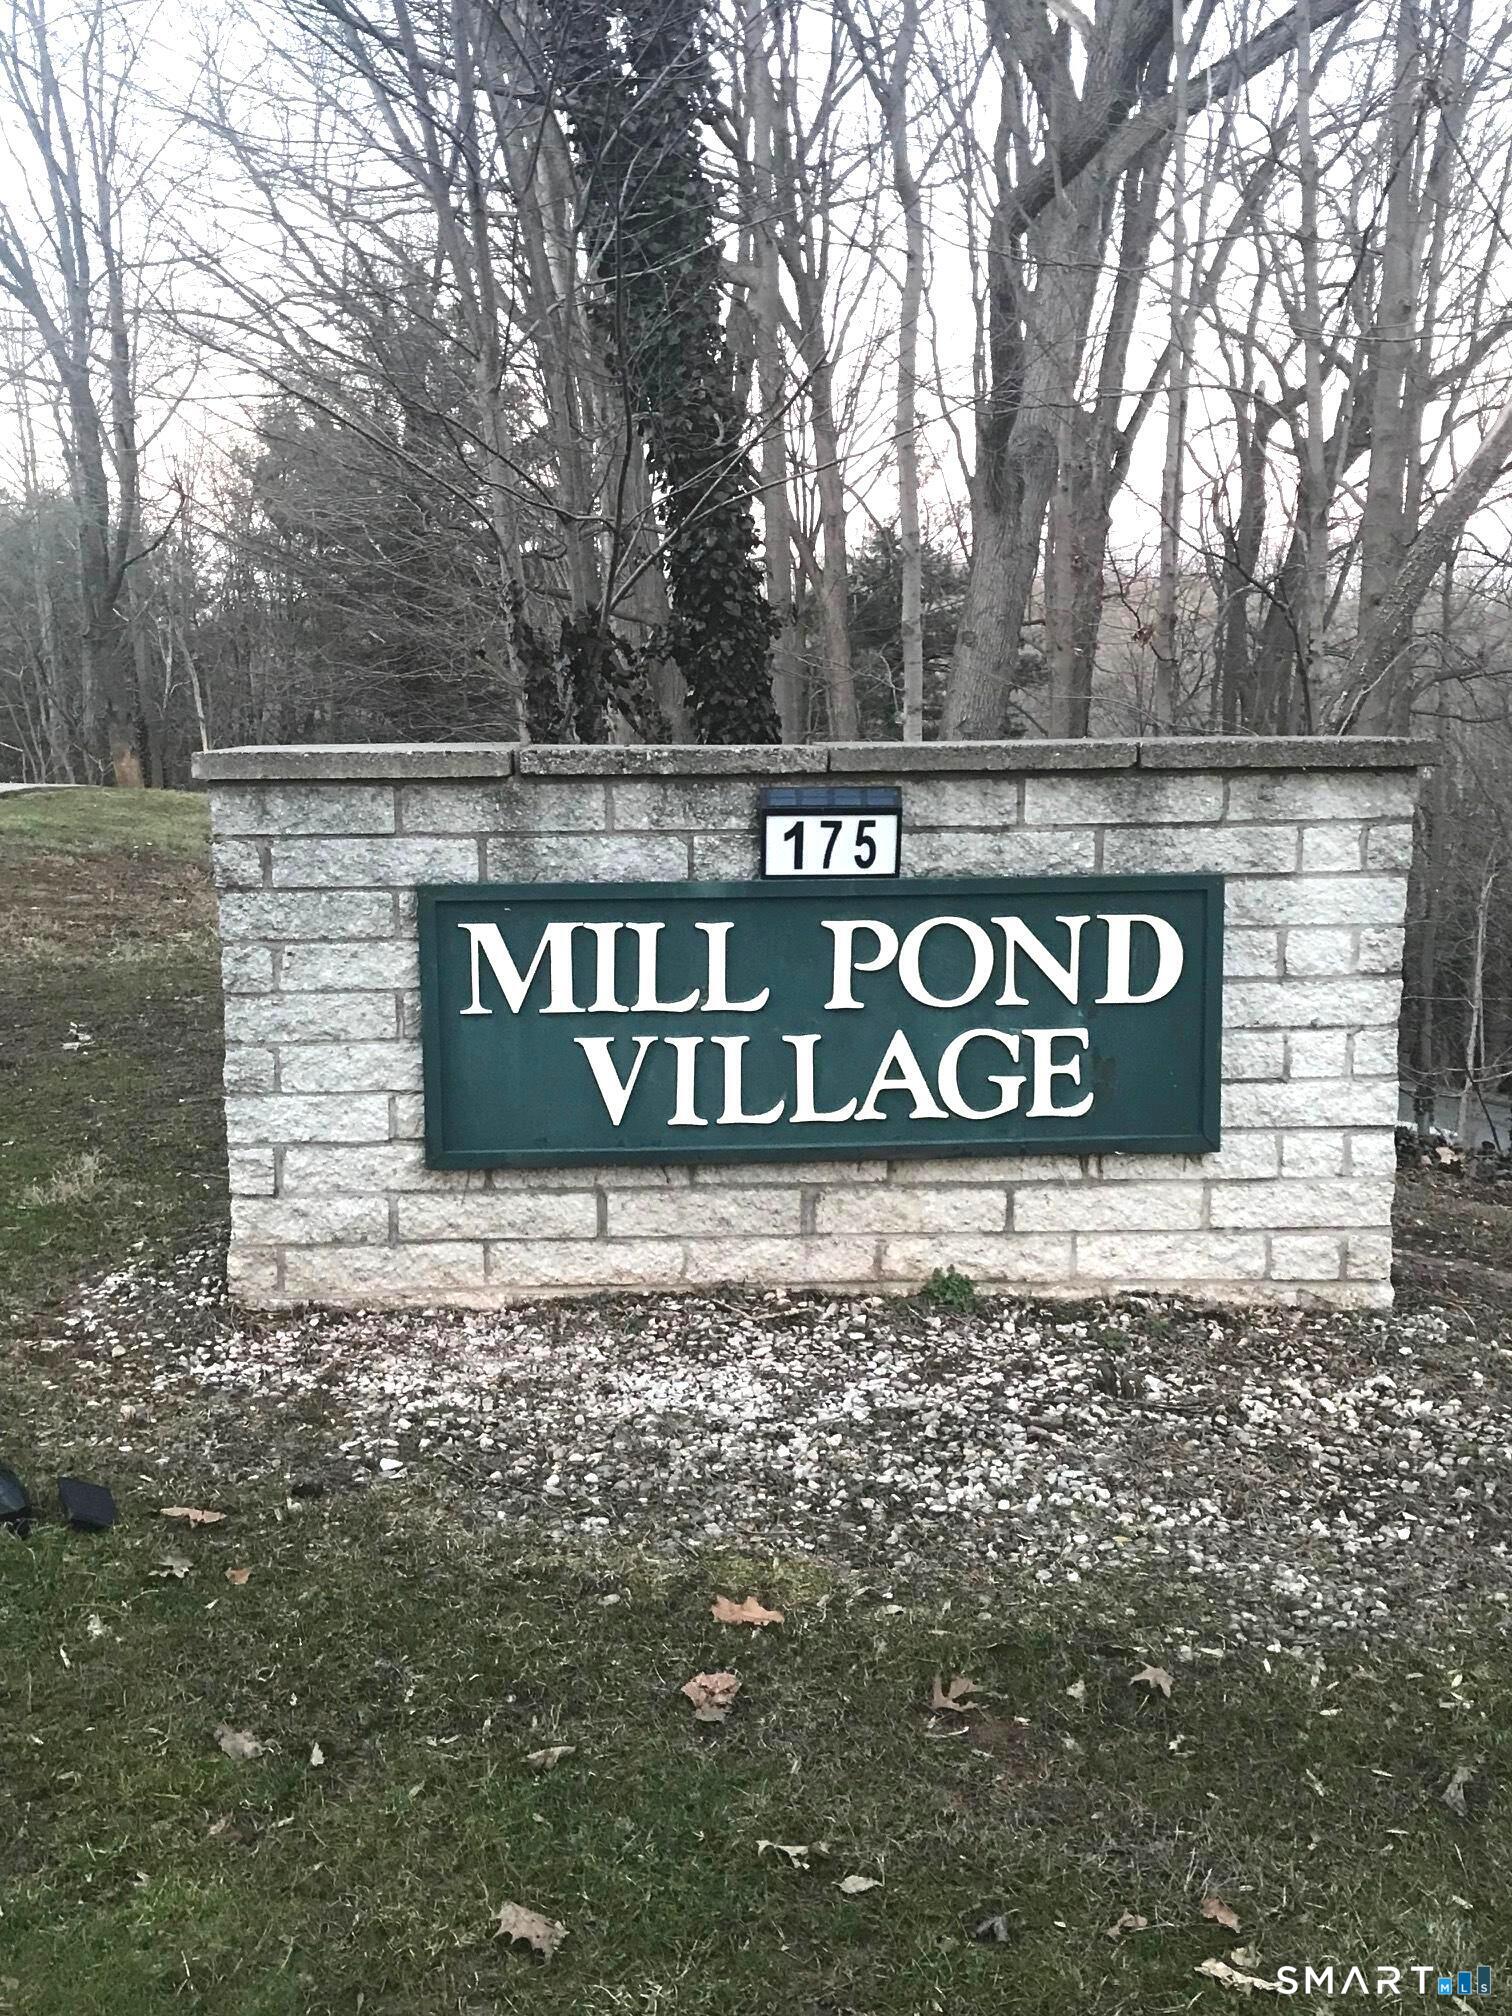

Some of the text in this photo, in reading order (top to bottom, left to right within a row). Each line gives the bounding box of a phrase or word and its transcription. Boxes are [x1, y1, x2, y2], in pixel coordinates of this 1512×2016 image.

[784, 820, 876, 870] 175
[457, 914, 1184, 1016] MILL POND
[573, 1027, 1094, 1127] VILLAGE
